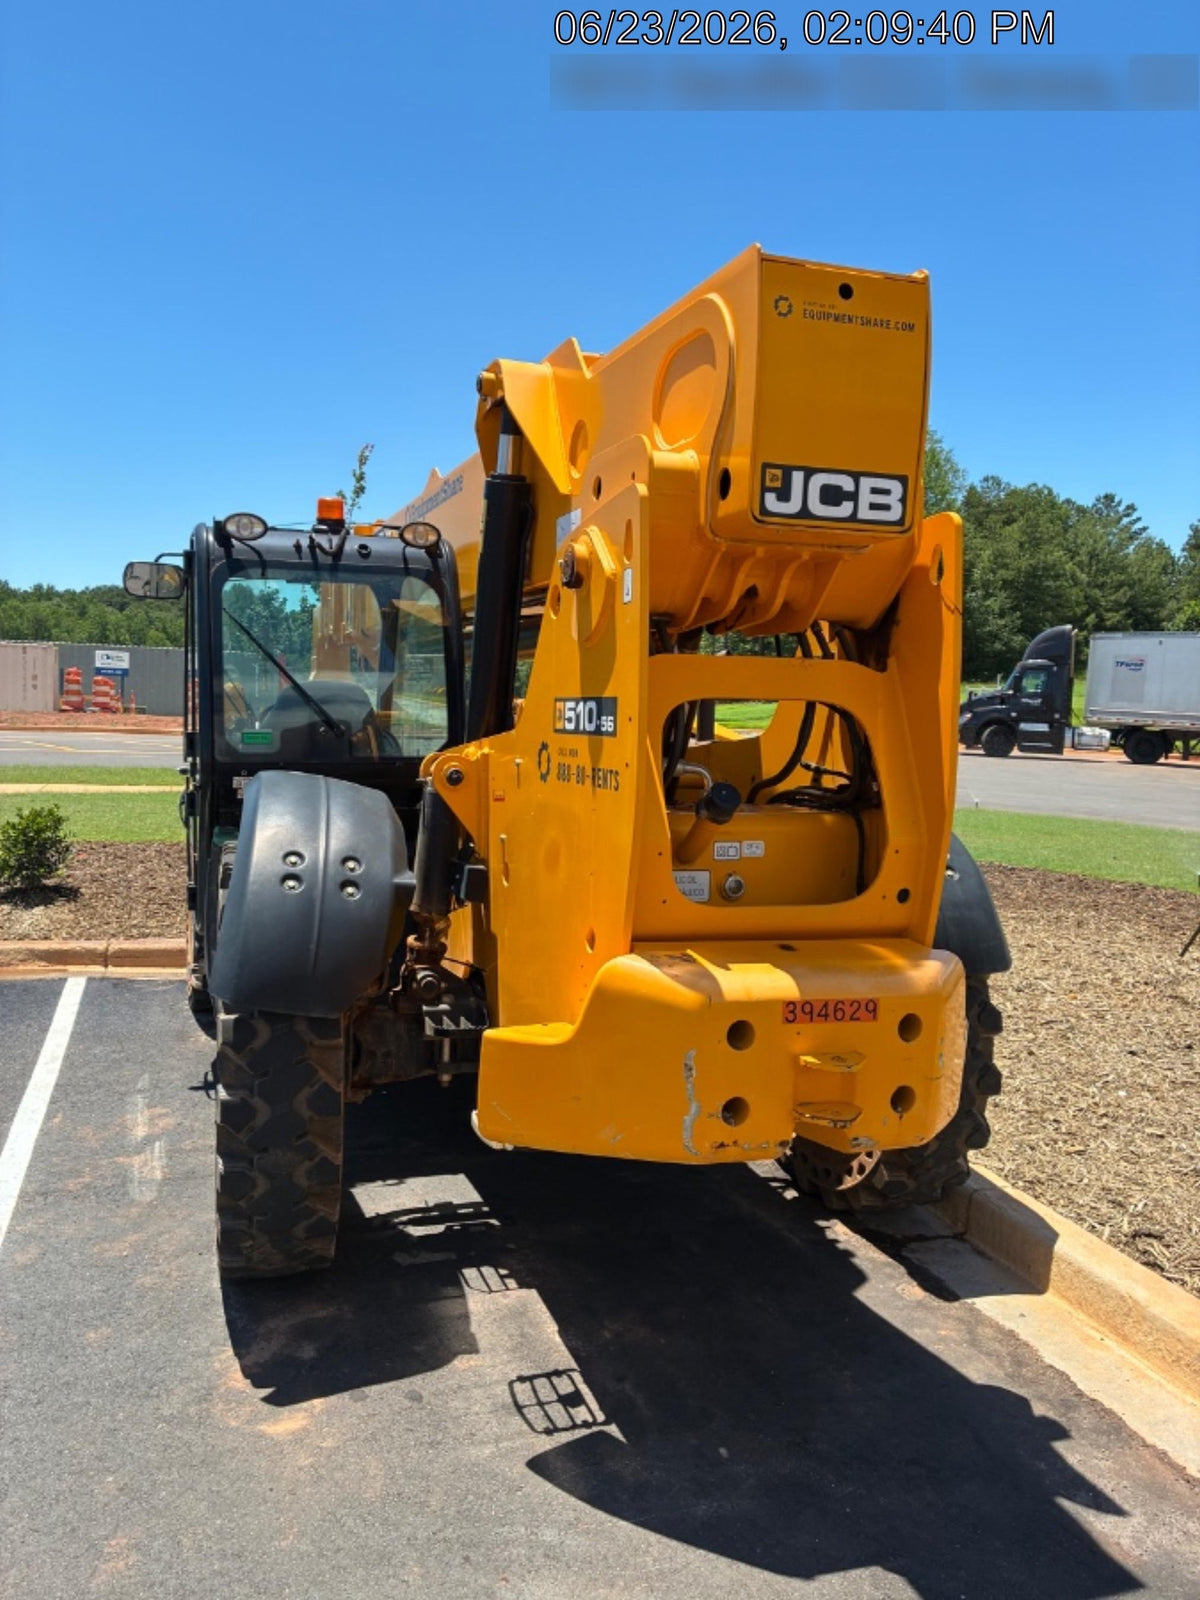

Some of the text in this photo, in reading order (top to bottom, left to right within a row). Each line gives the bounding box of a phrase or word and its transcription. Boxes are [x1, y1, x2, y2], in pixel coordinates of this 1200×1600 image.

[803, 309, 915, 332] EQUIPMENTSHARE.COM
[764, 470, 904, 522] JCB
[785, 998, 878, 1023] 394629
